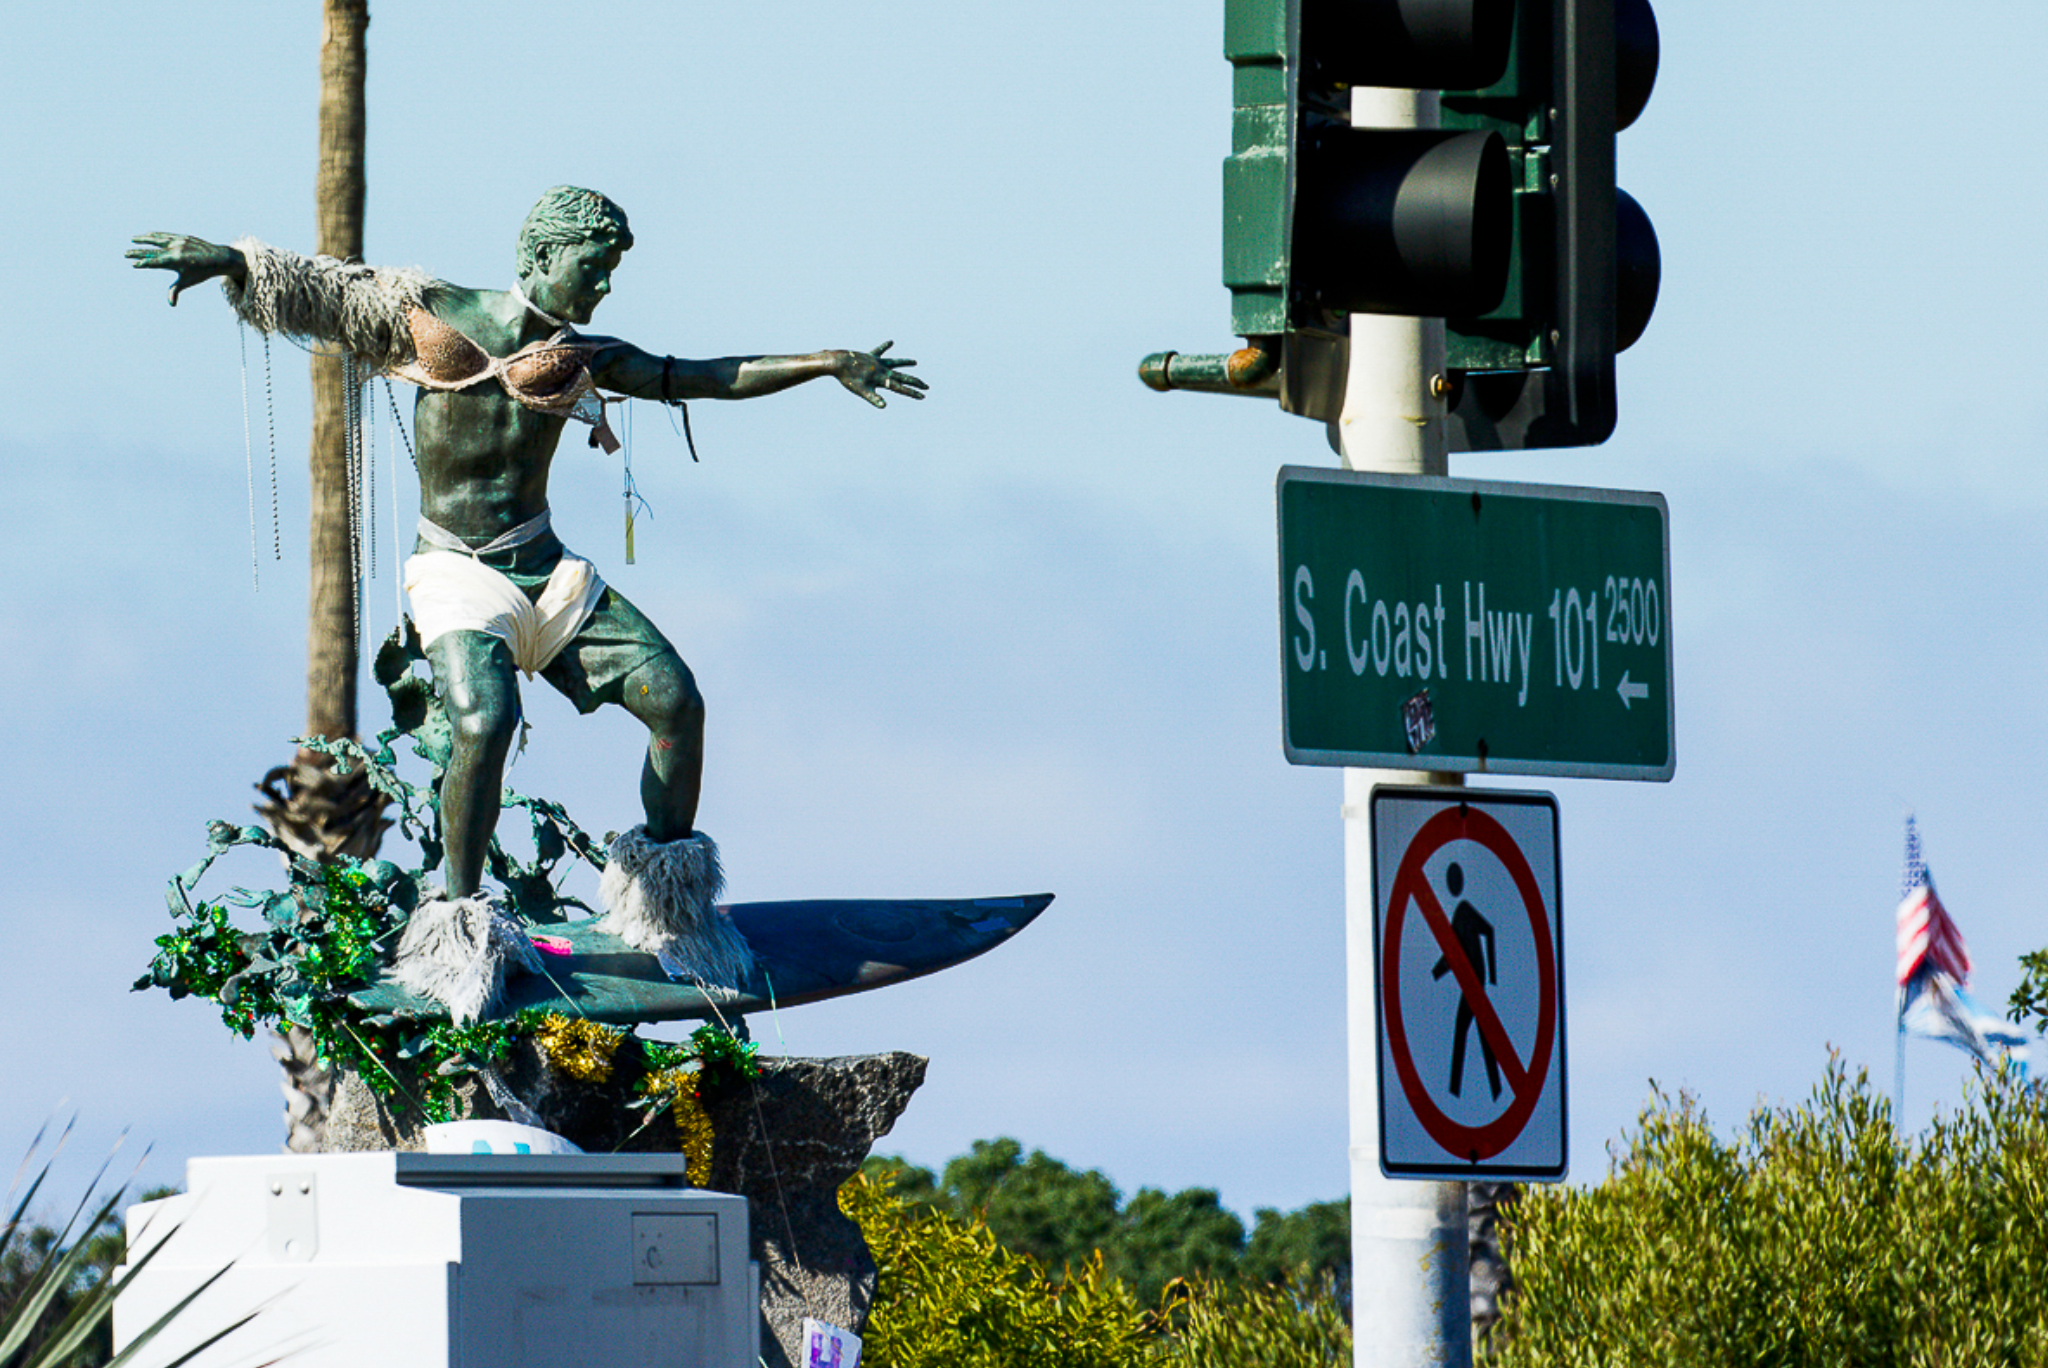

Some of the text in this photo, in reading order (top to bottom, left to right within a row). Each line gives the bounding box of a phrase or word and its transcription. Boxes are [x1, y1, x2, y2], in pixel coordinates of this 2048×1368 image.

[1293, 564, 1600, 707] S. Coast Hwy 101
[1604, 574, 1660, 648] 2500
